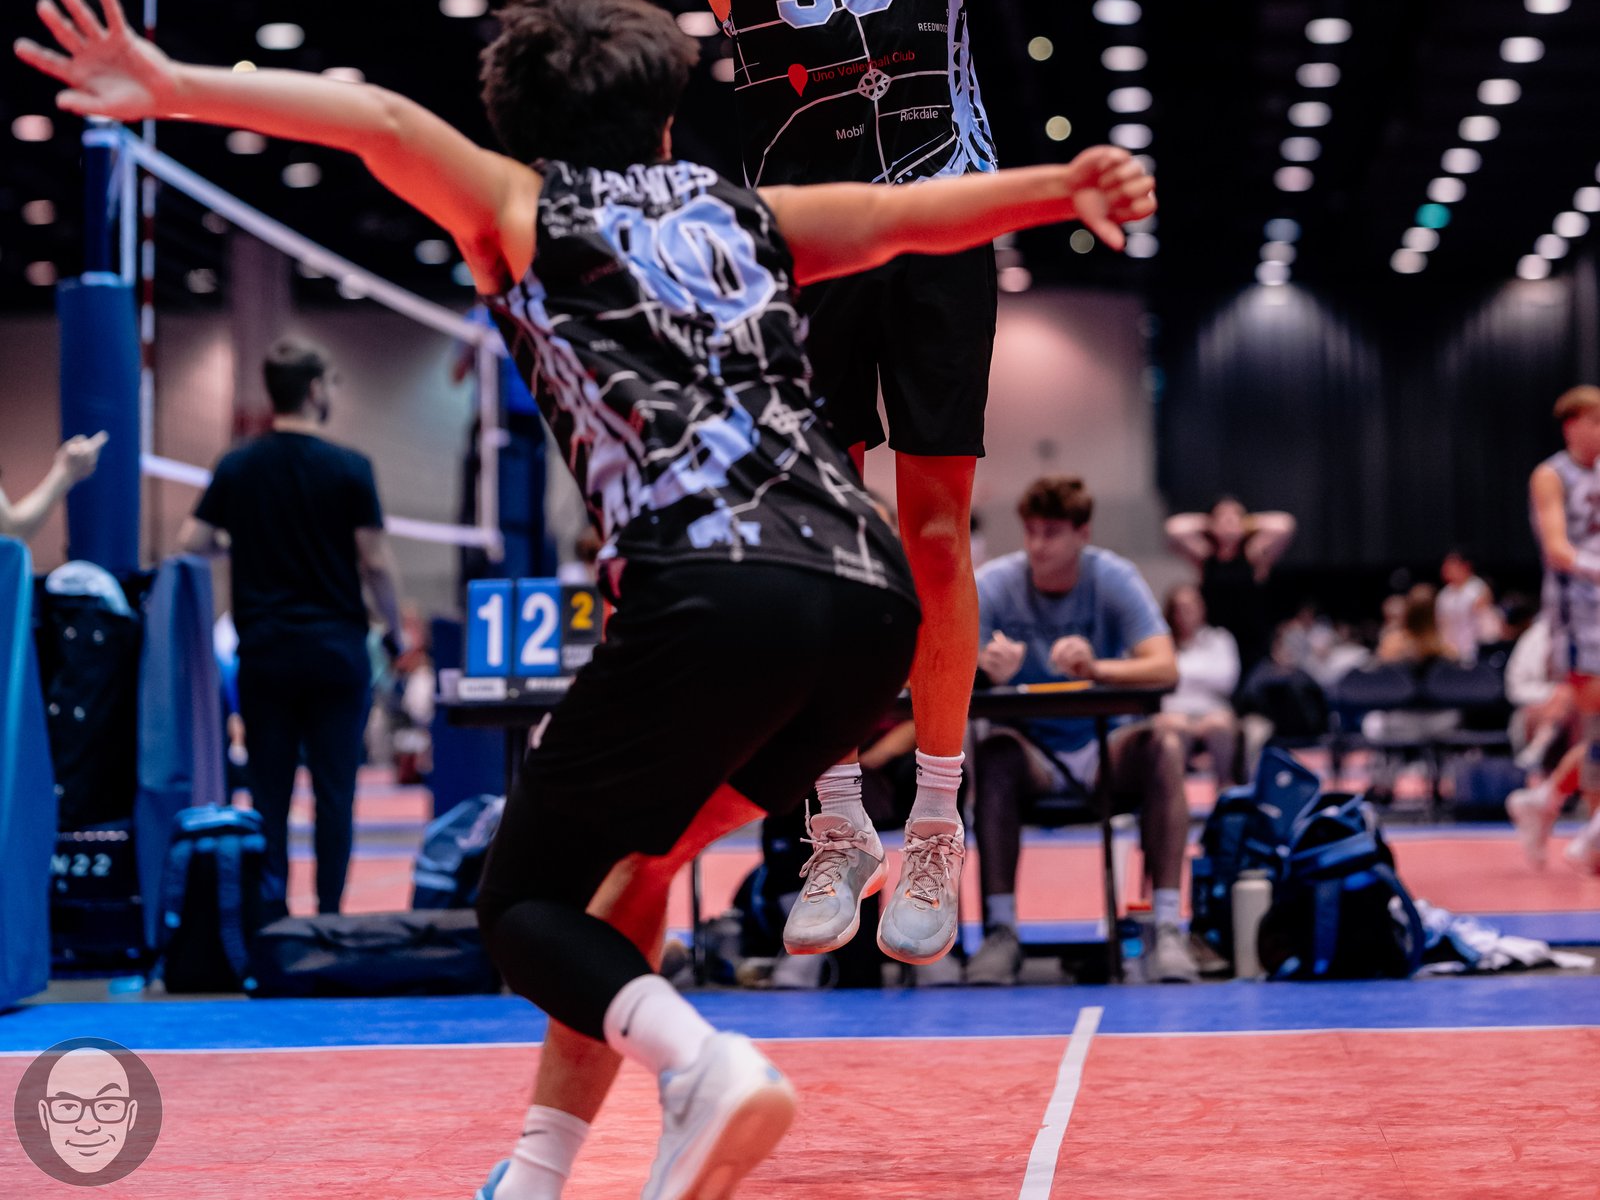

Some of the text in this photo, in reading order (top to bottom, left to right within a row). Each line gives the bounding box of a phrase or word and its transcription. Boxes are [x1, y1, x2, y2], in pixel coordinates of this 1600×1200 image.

[812, 49, 916, 83] Uno Volleyball Club
[570, 591, 594, 630] 2
